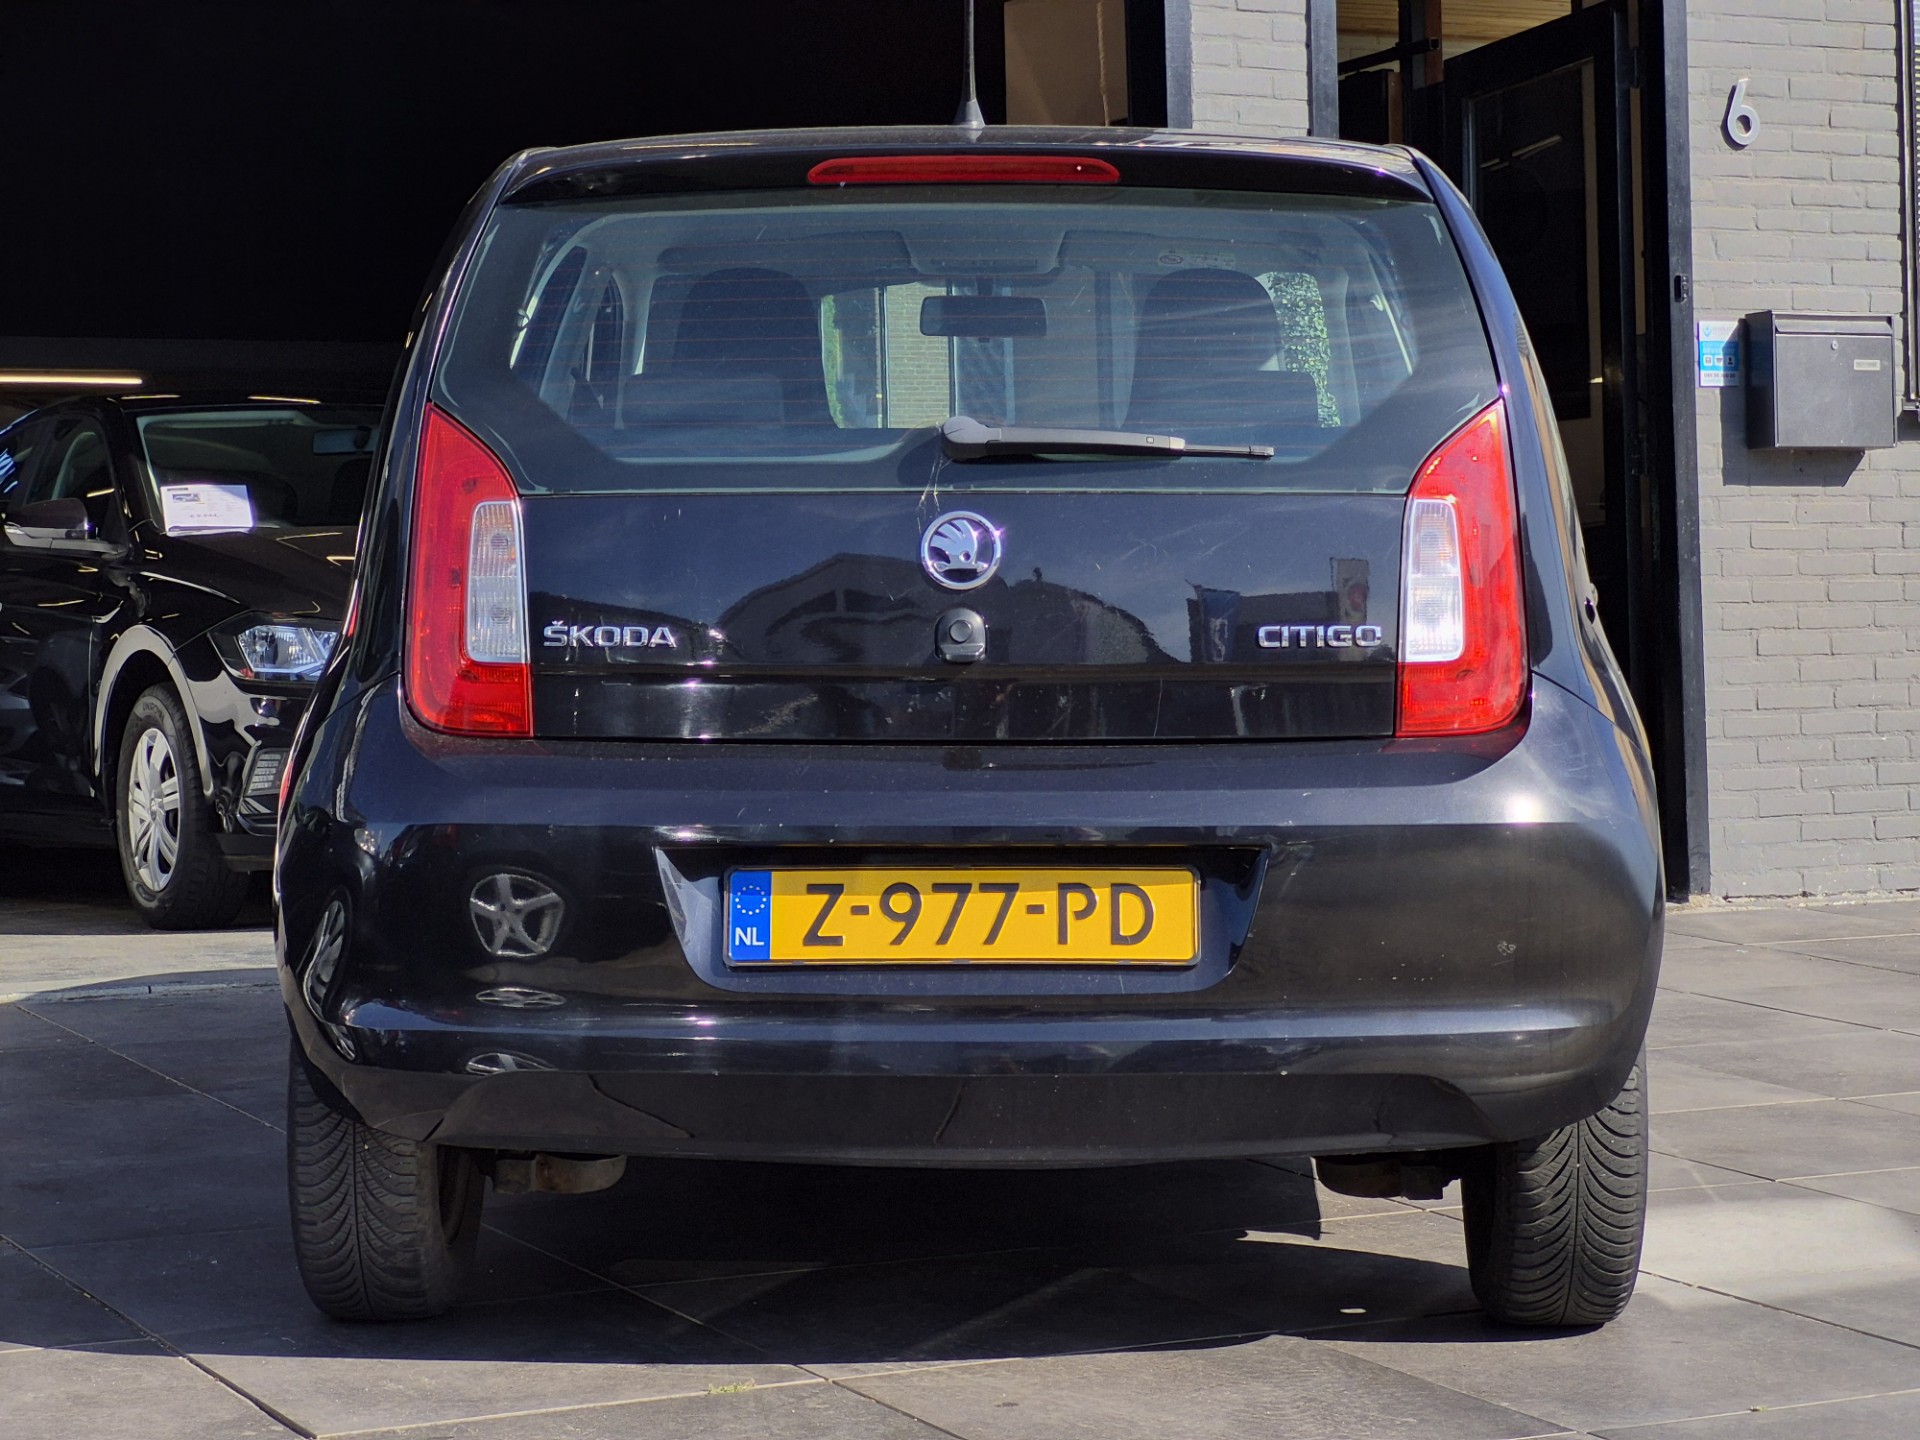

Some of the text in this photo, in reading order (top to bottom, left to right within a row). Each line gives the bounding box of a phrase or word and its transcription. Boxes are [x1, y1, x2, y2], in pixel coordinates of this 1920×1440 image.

[1727, 78, 1760, 146] 6
[543, 620, 677, 648] ŠKODA
[1258, 625, 1382, 648] CITIGO
[802, 881, 1155, 946] Z-977-PD
[734, 926, 765, 946] NL
